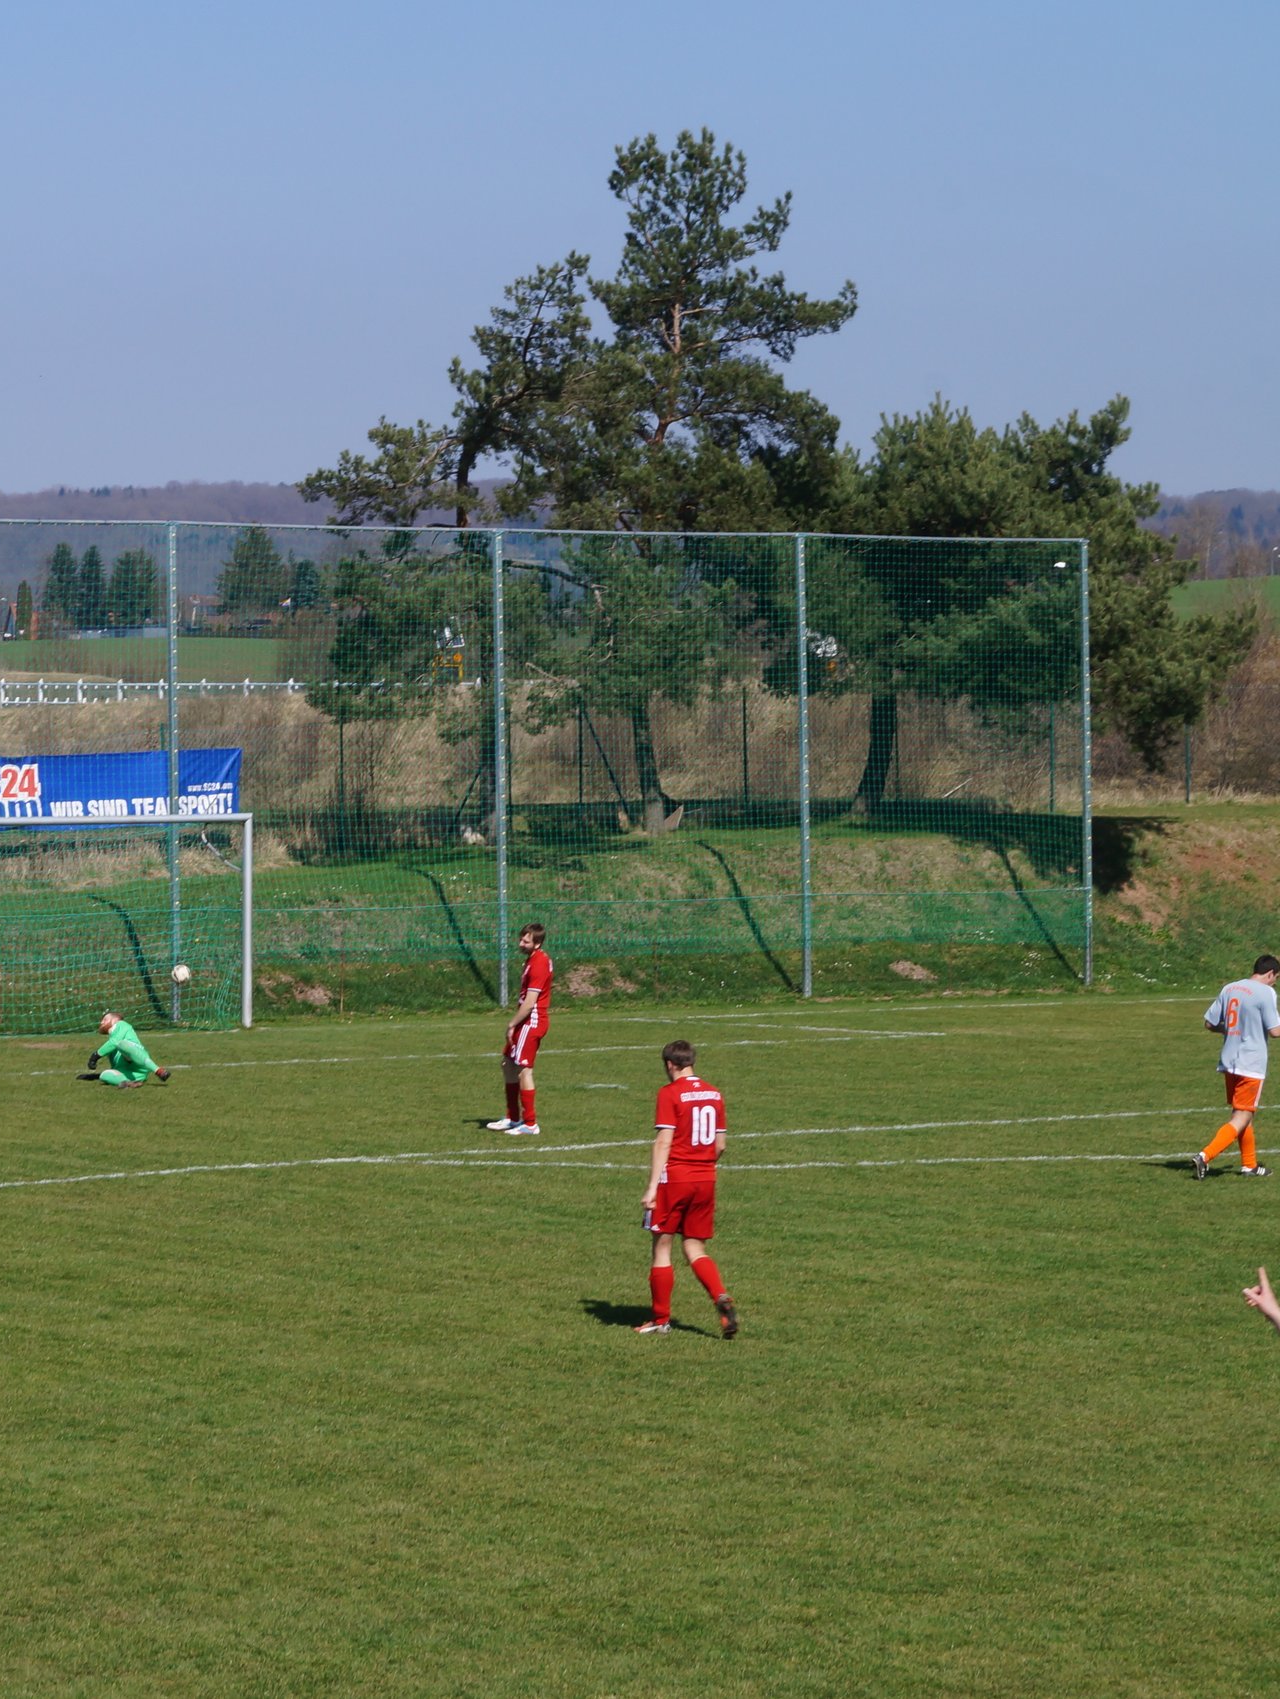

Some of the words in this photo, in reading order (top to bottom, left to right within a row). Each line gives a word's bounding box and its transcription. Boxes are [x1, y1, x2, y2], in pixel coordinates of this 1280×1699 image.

[49, 799, 84, 817] WIR
[87, 798, 128, 817] SIND
[1226, 997, 1240, 1029] 6
[691, 1105, 717, 1147] 10
